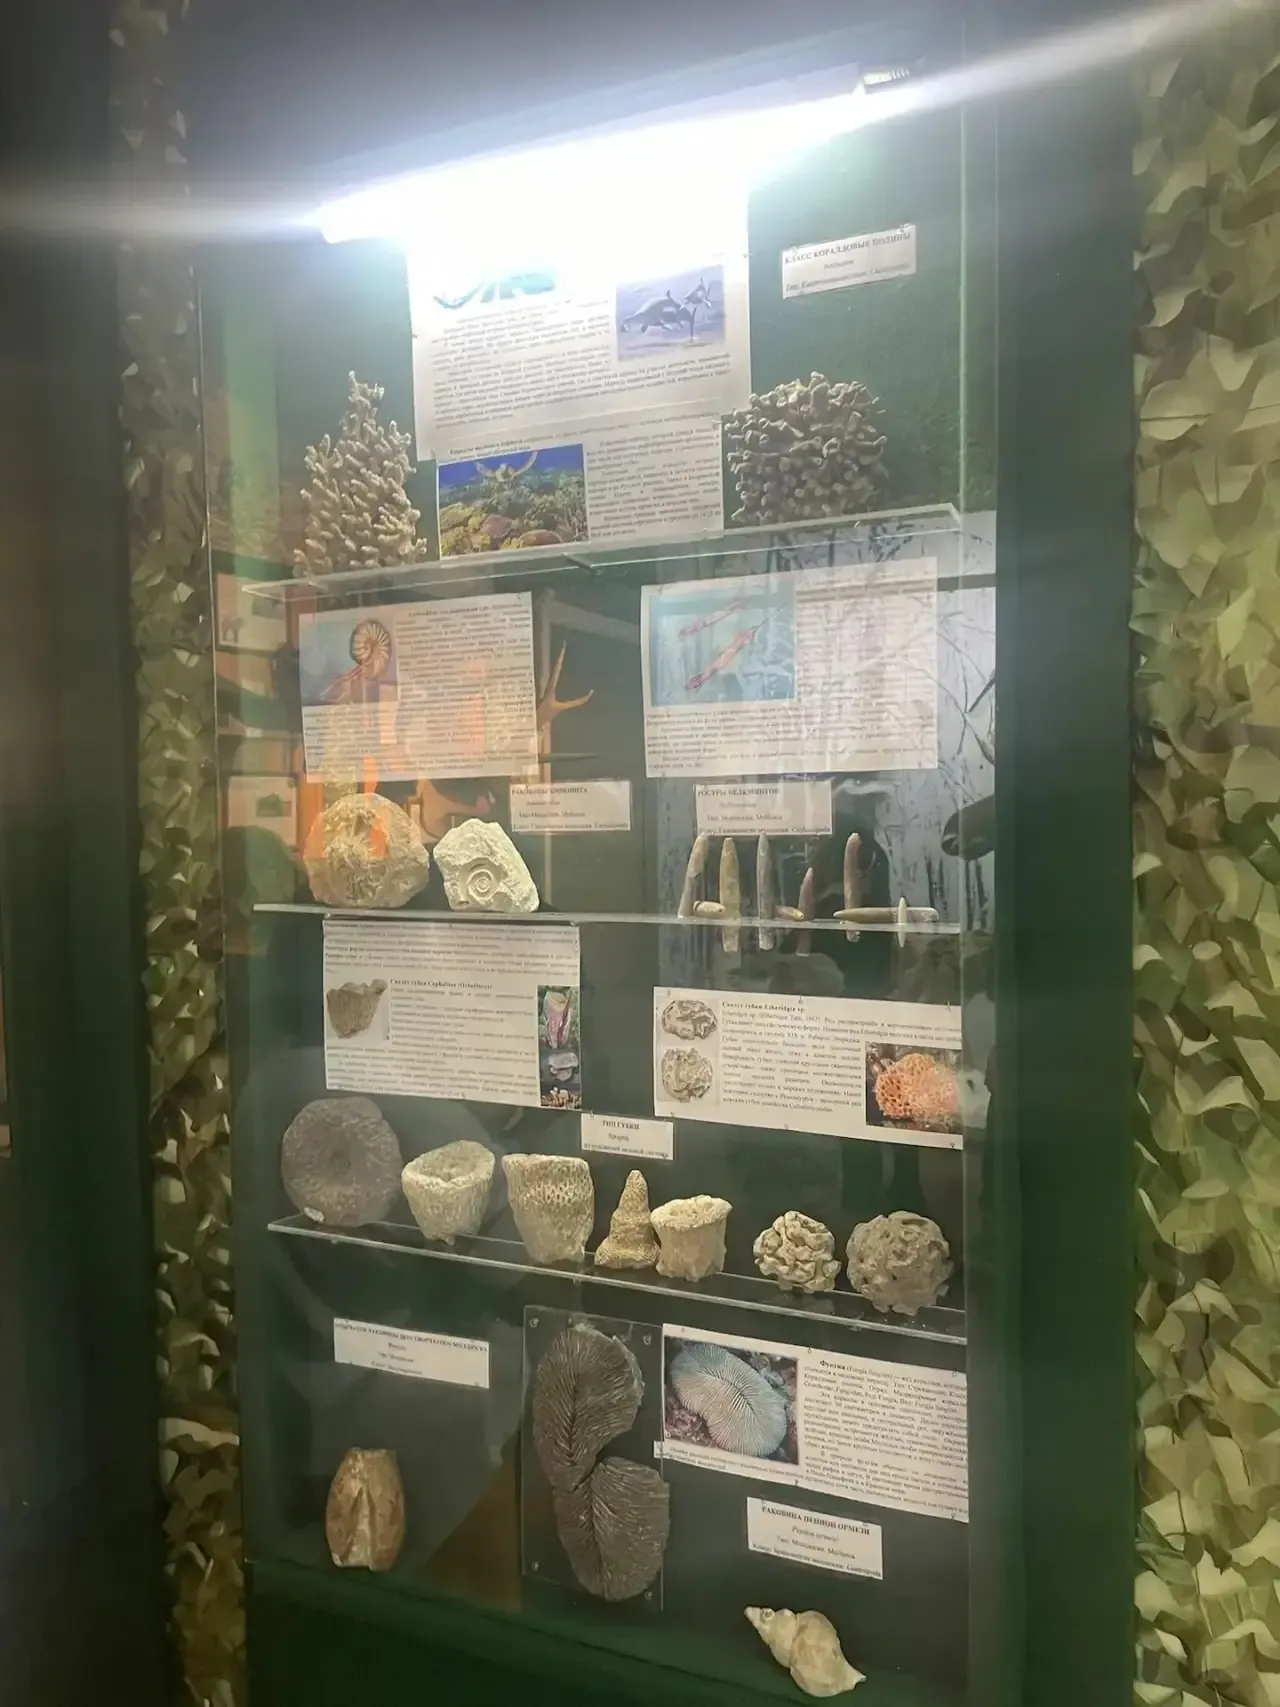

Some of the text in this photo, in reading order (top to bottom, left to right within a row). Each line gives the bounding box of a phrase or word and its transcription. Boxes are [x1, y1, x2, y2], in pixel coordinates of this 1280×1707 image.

[785, 252, 812, 264] КЛАСС
[814, 242, 869, 258] КОРАЛЛОВЫЕ
[762, 1506, 802, 1520] РАКОВИНА
